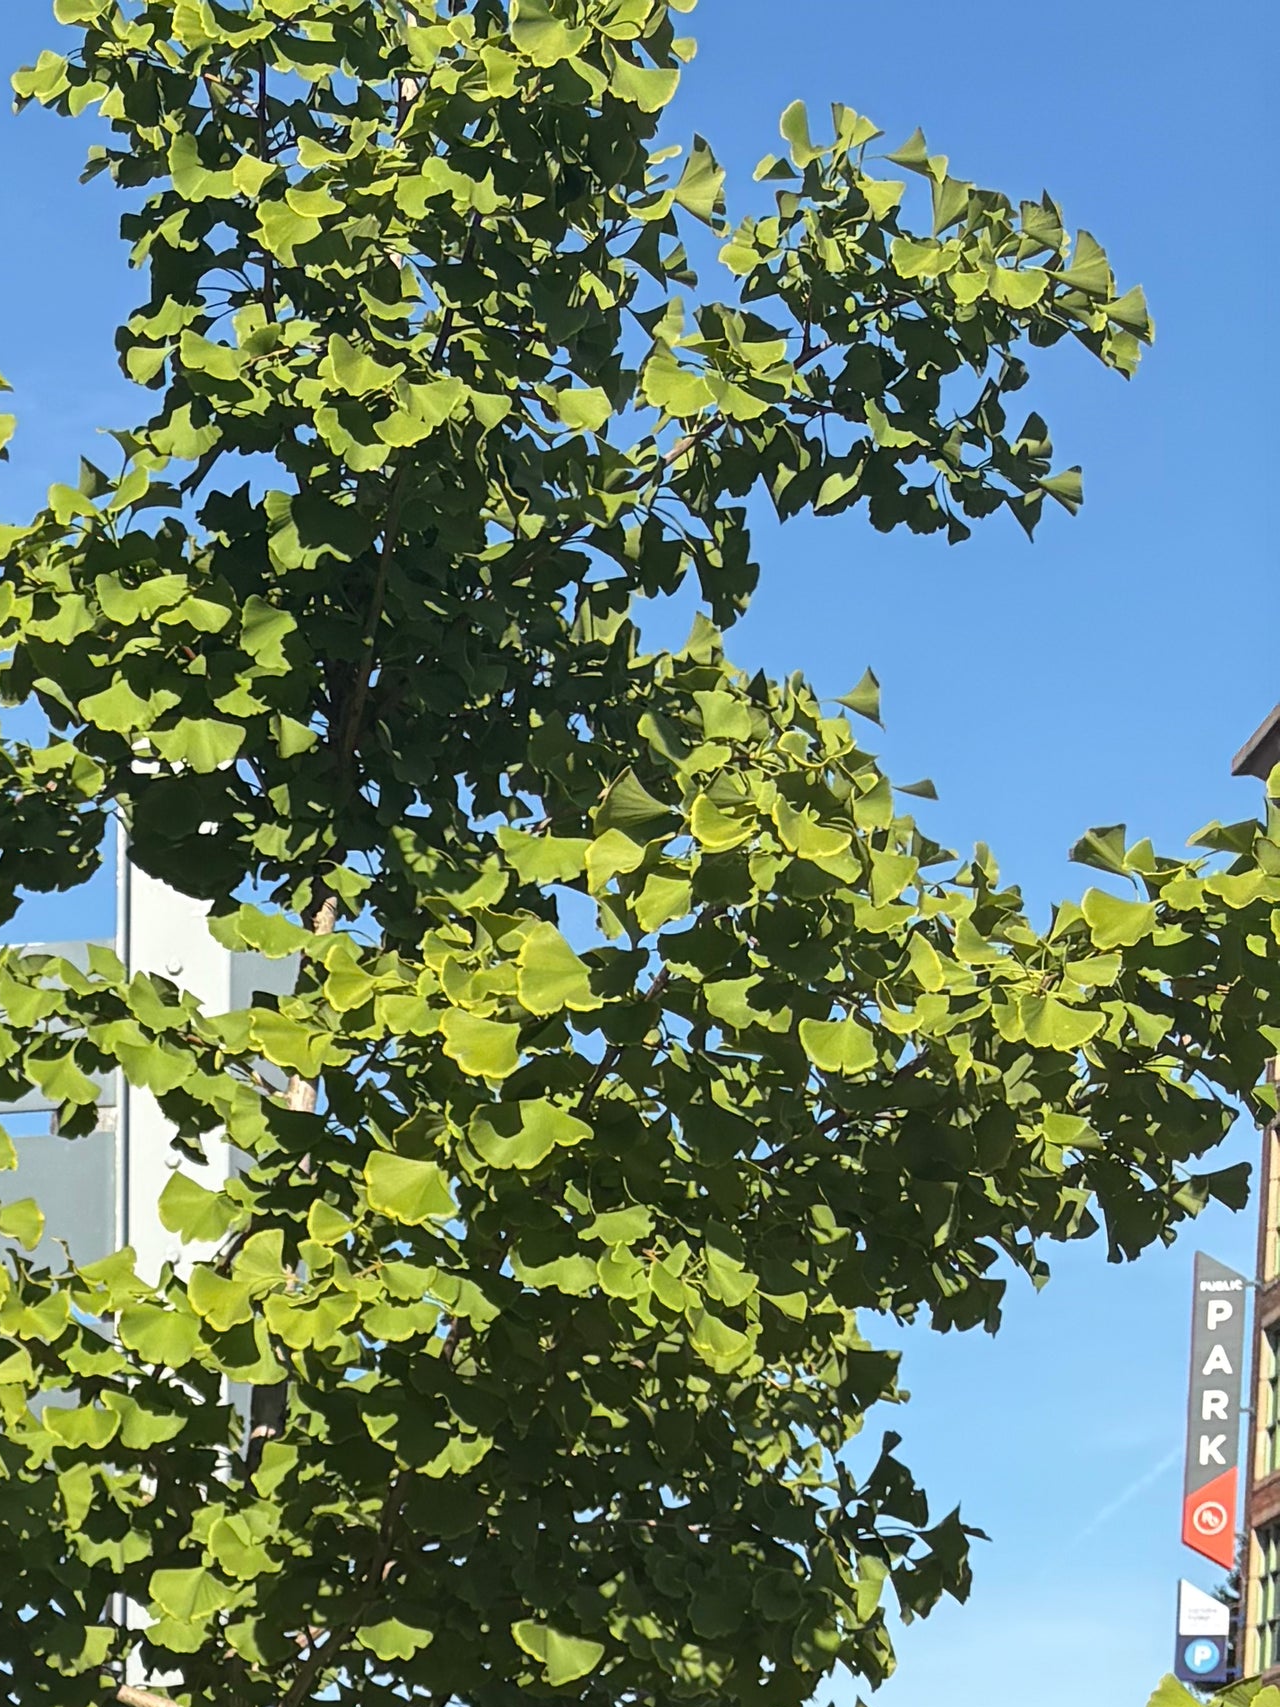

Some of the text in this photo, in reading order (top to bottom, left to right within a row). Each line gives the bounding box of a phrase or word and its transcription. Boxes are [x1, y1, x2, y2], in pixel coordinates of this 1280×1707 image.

[1200, 1279, 1243, 1292] PUBLIC
[1199, 1299, 1234, 1466] PARK
[1193, 1644, 1213, 1667] P
